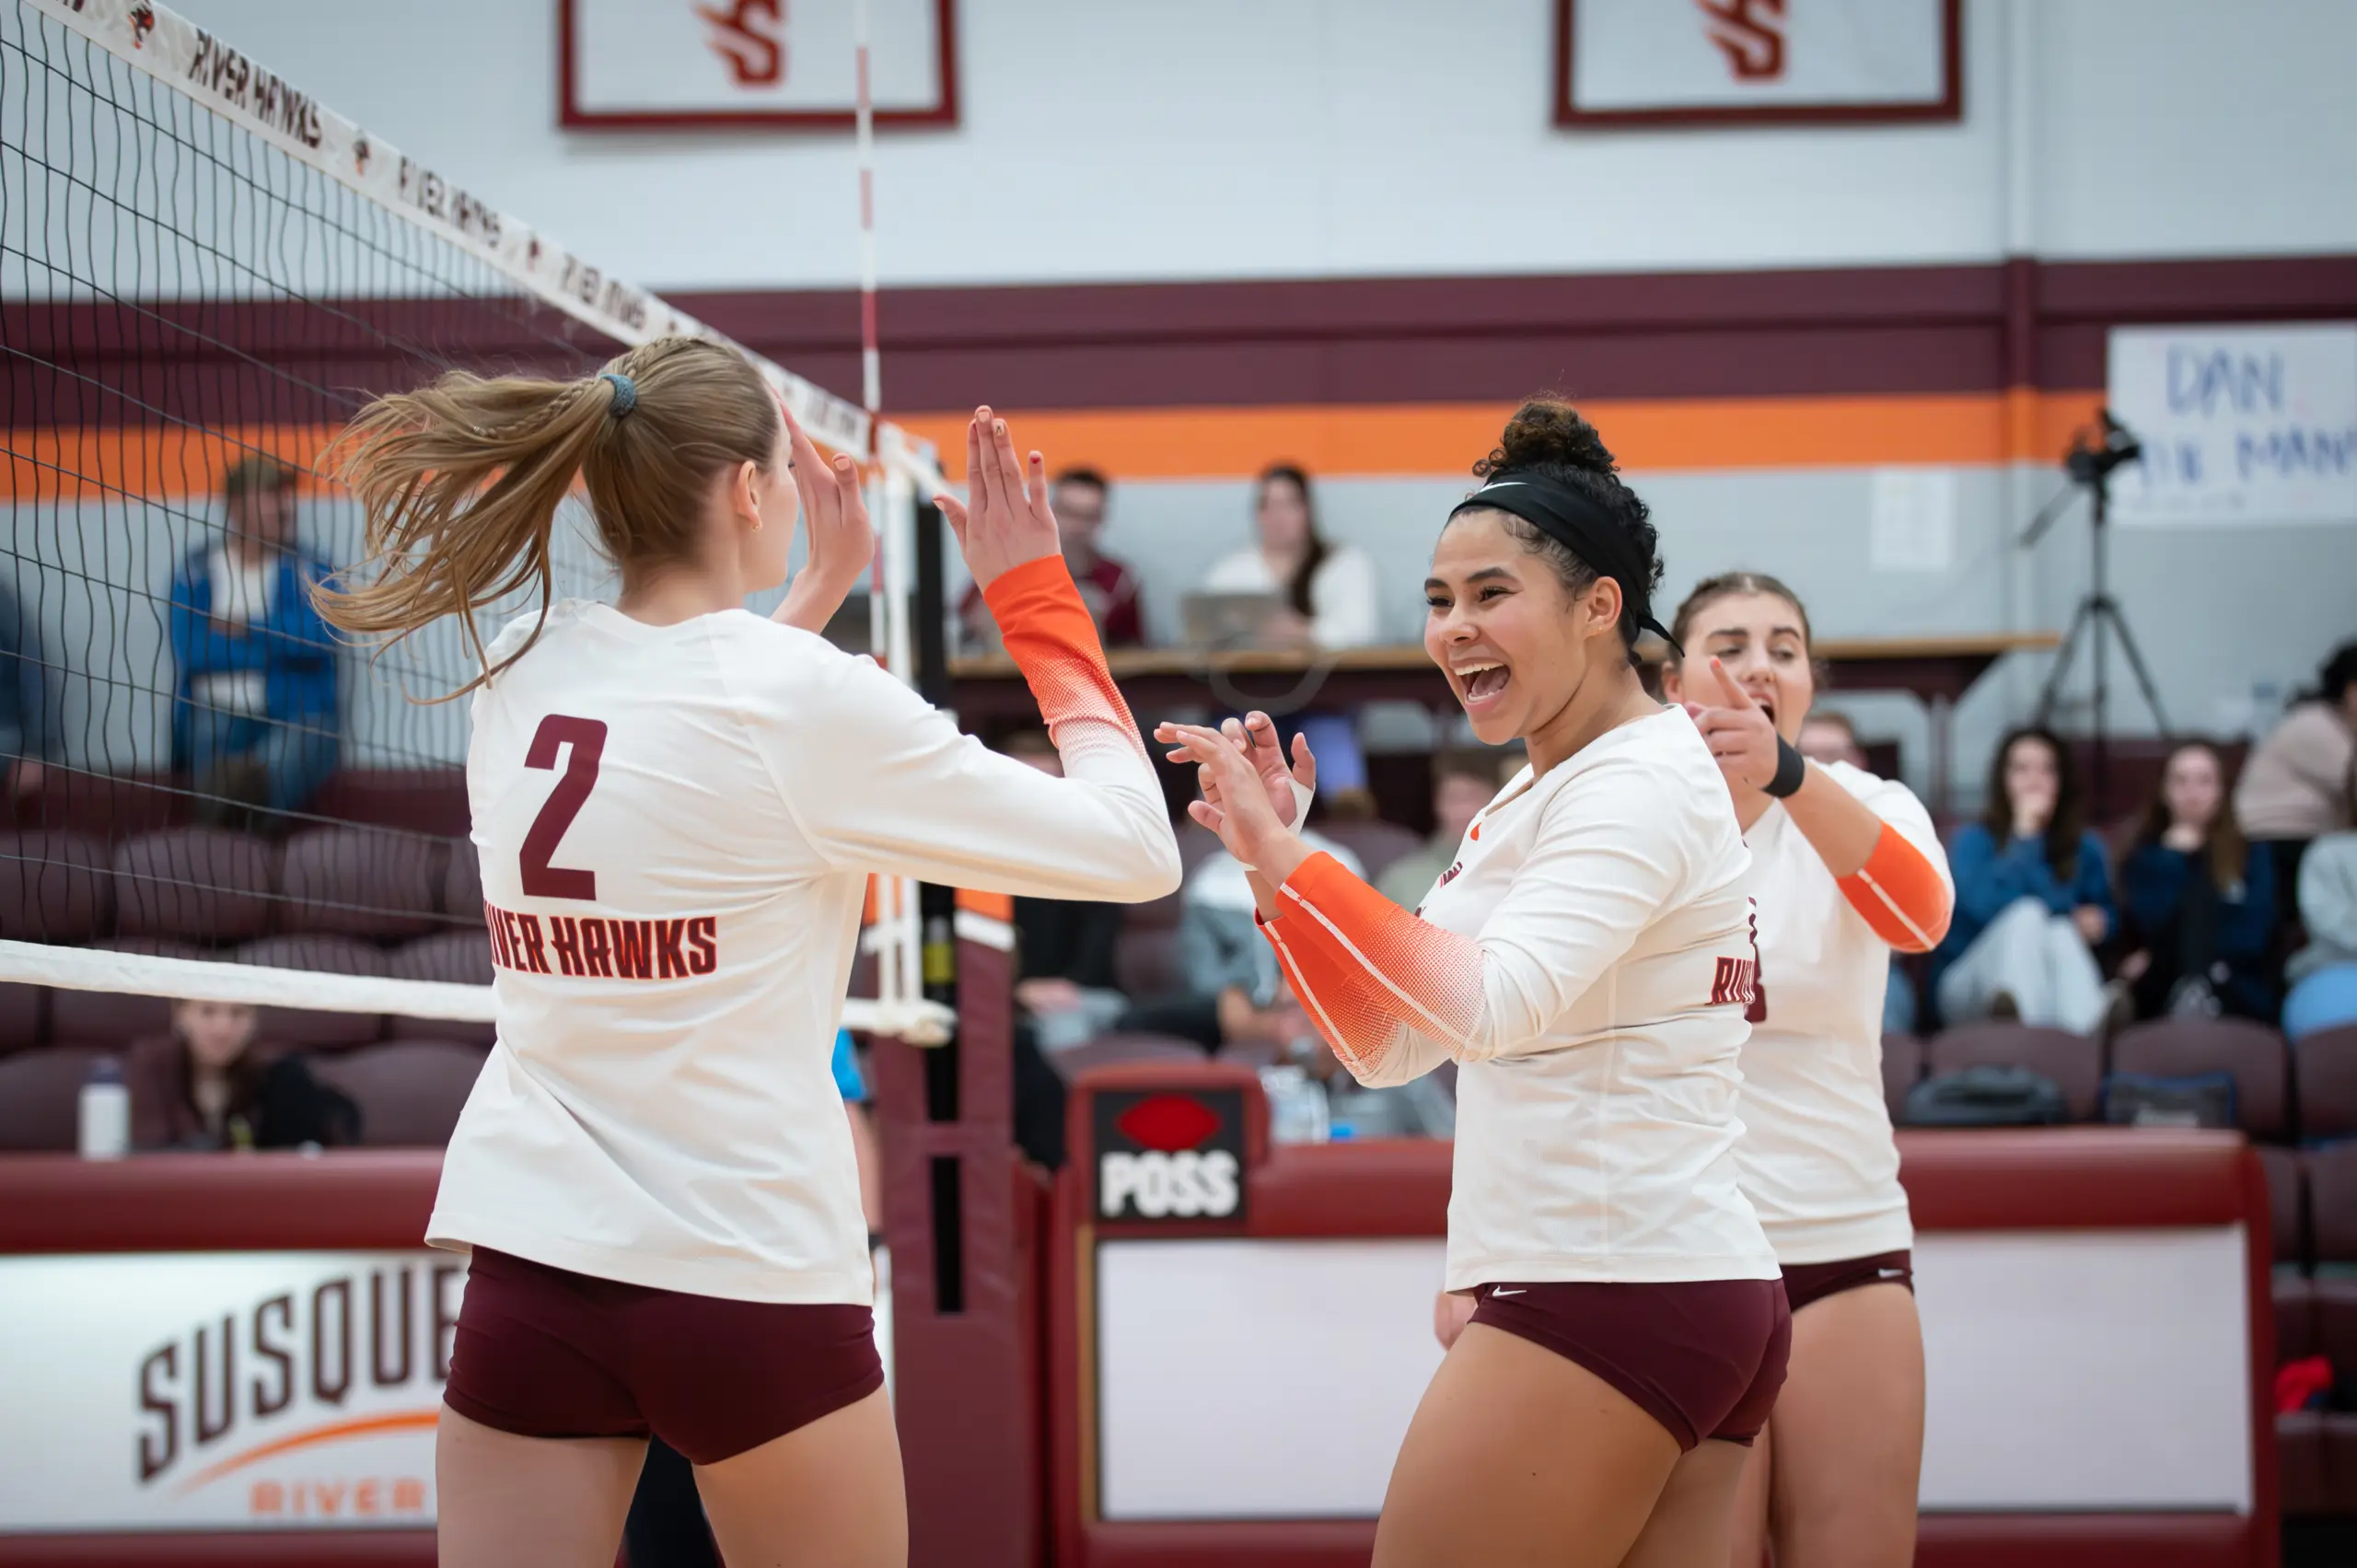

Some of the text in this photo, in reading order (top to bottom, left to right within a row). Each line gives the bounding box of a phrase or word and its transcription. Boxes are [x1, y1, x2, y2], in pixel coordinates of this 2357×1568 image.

[2167, 344, 2284, 418] DAN
[519, 714, 609, 901] 2
[549, 915, 717, 980] HAWKS
[1100, 1150, 1239, 1218] POSS
[139, 1264, 463, 1484] SUSQUE
[250, 1478, 425, 1516] RIVER
